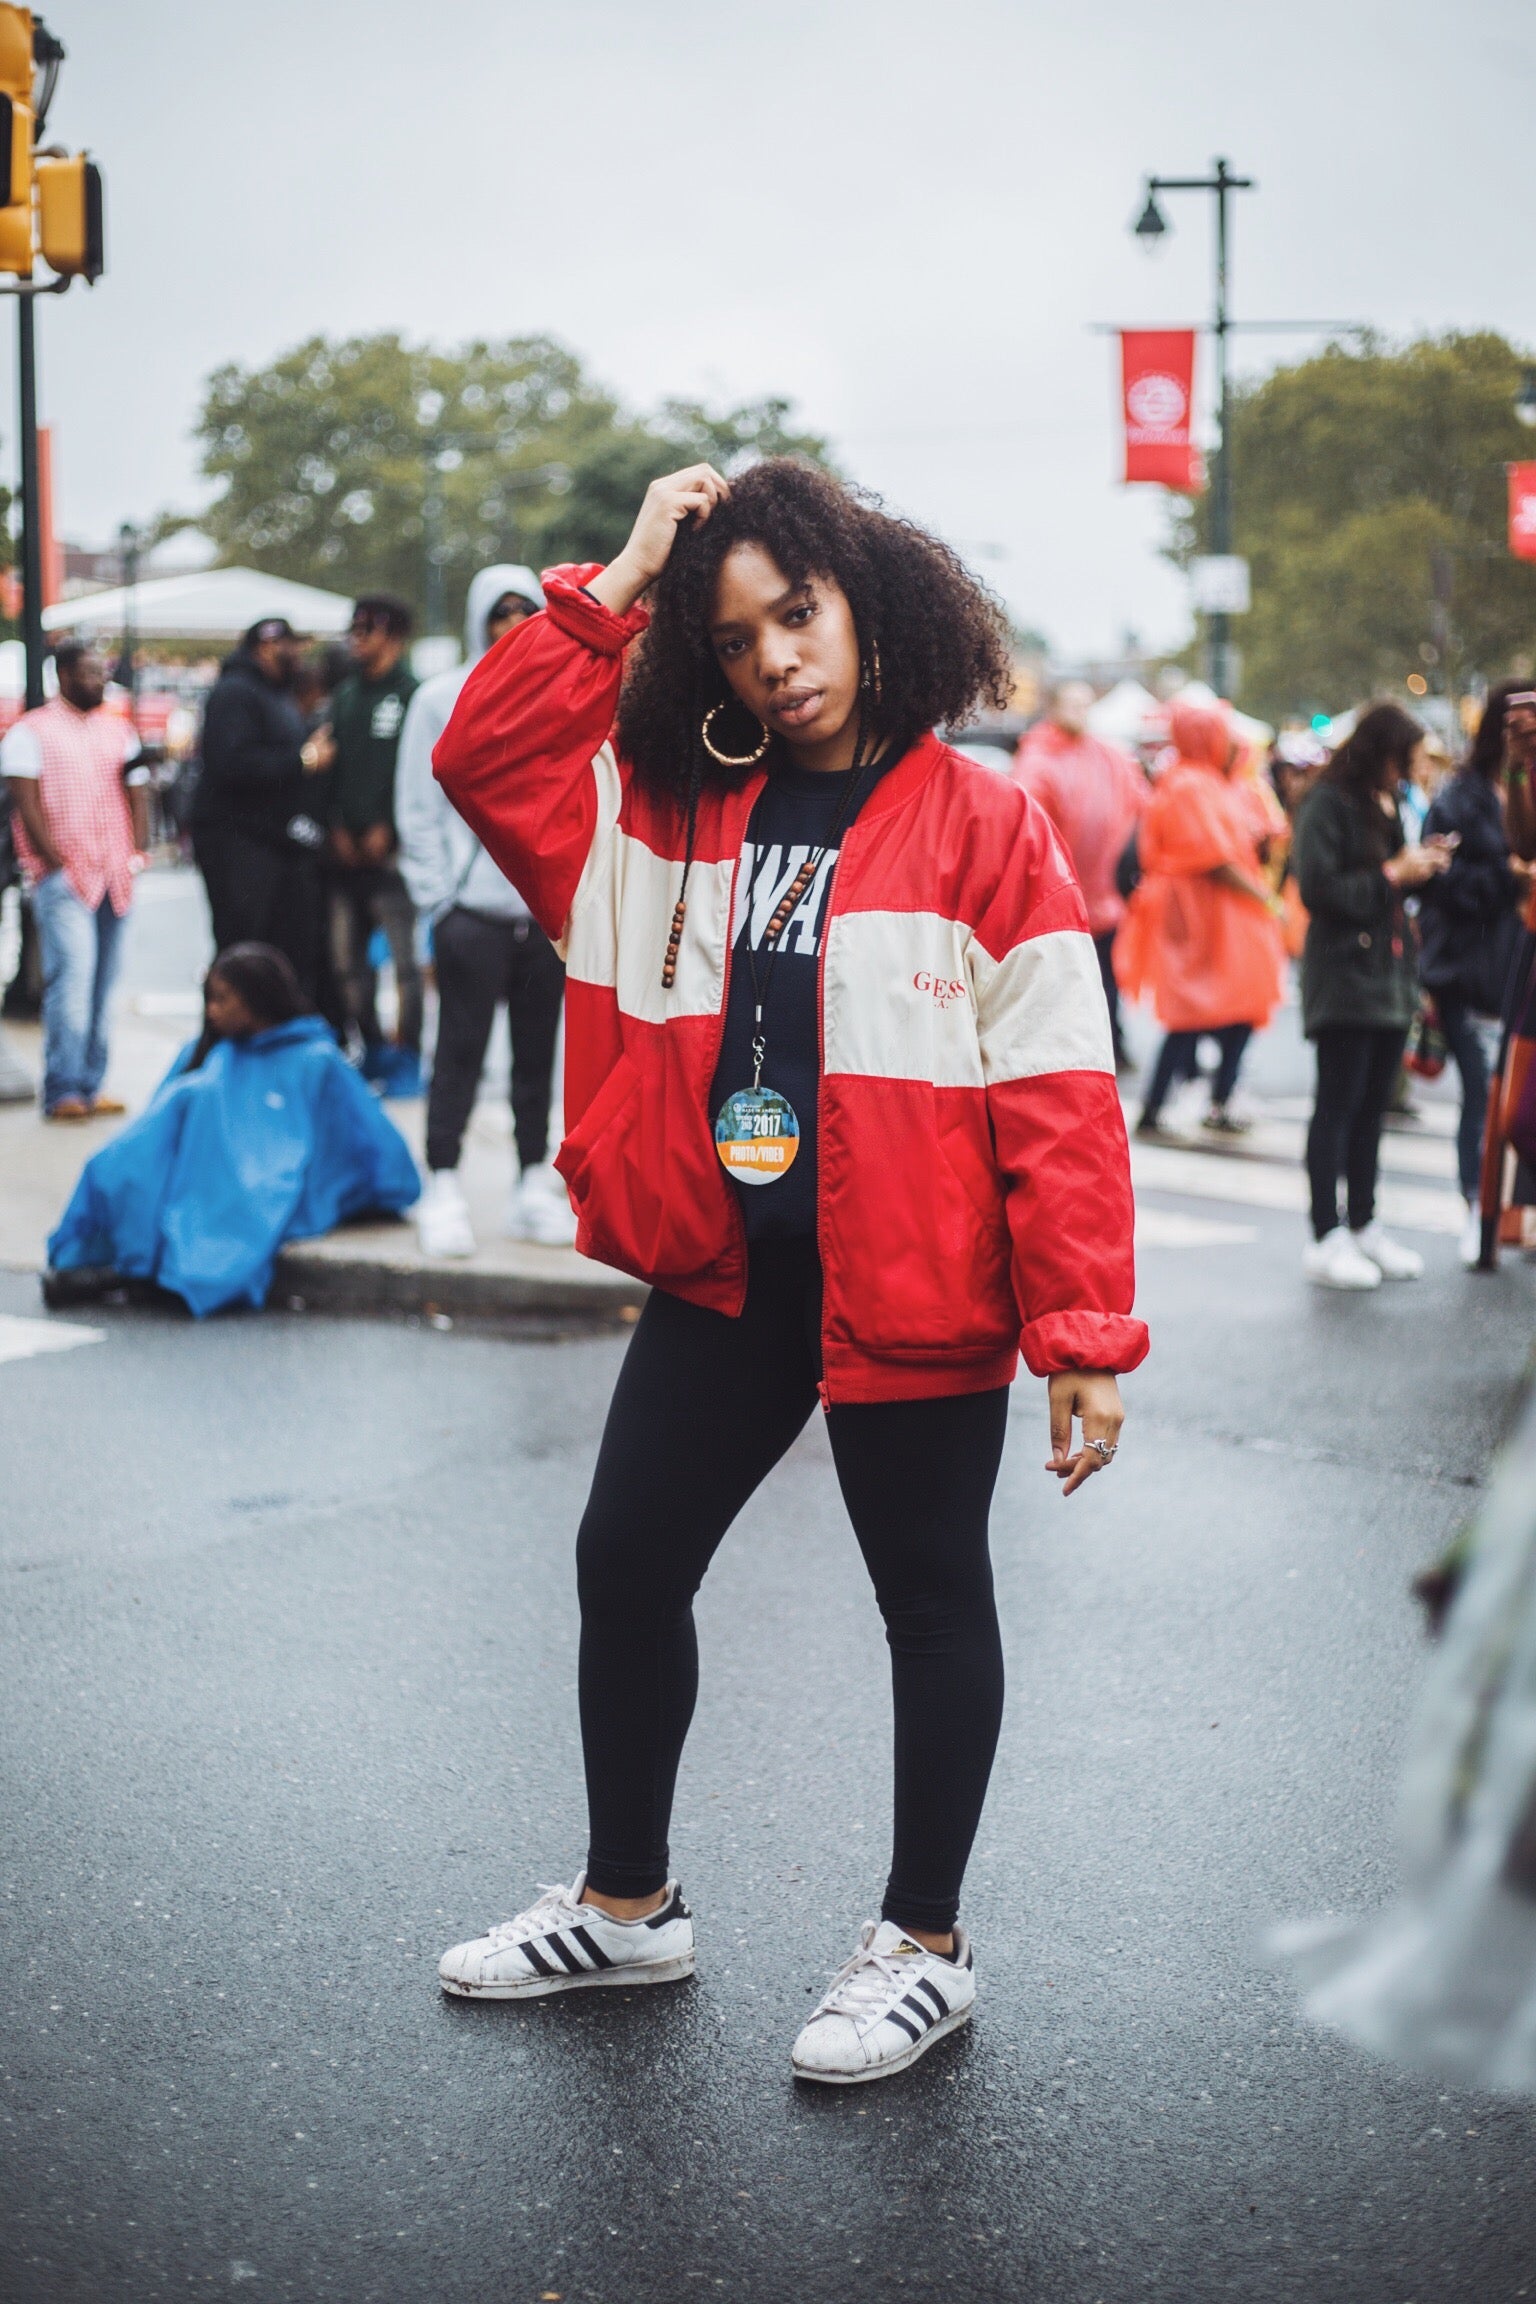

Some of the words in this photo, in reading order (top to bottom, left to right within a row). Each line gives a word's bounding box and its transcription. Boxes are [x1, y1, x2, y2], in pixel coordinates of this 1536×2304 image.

[733, 842, 839, 957] WA
[753, 1115, 781, 1136] 2017
[730, 1145, 784, 1163] PHOTO/VIDEO
